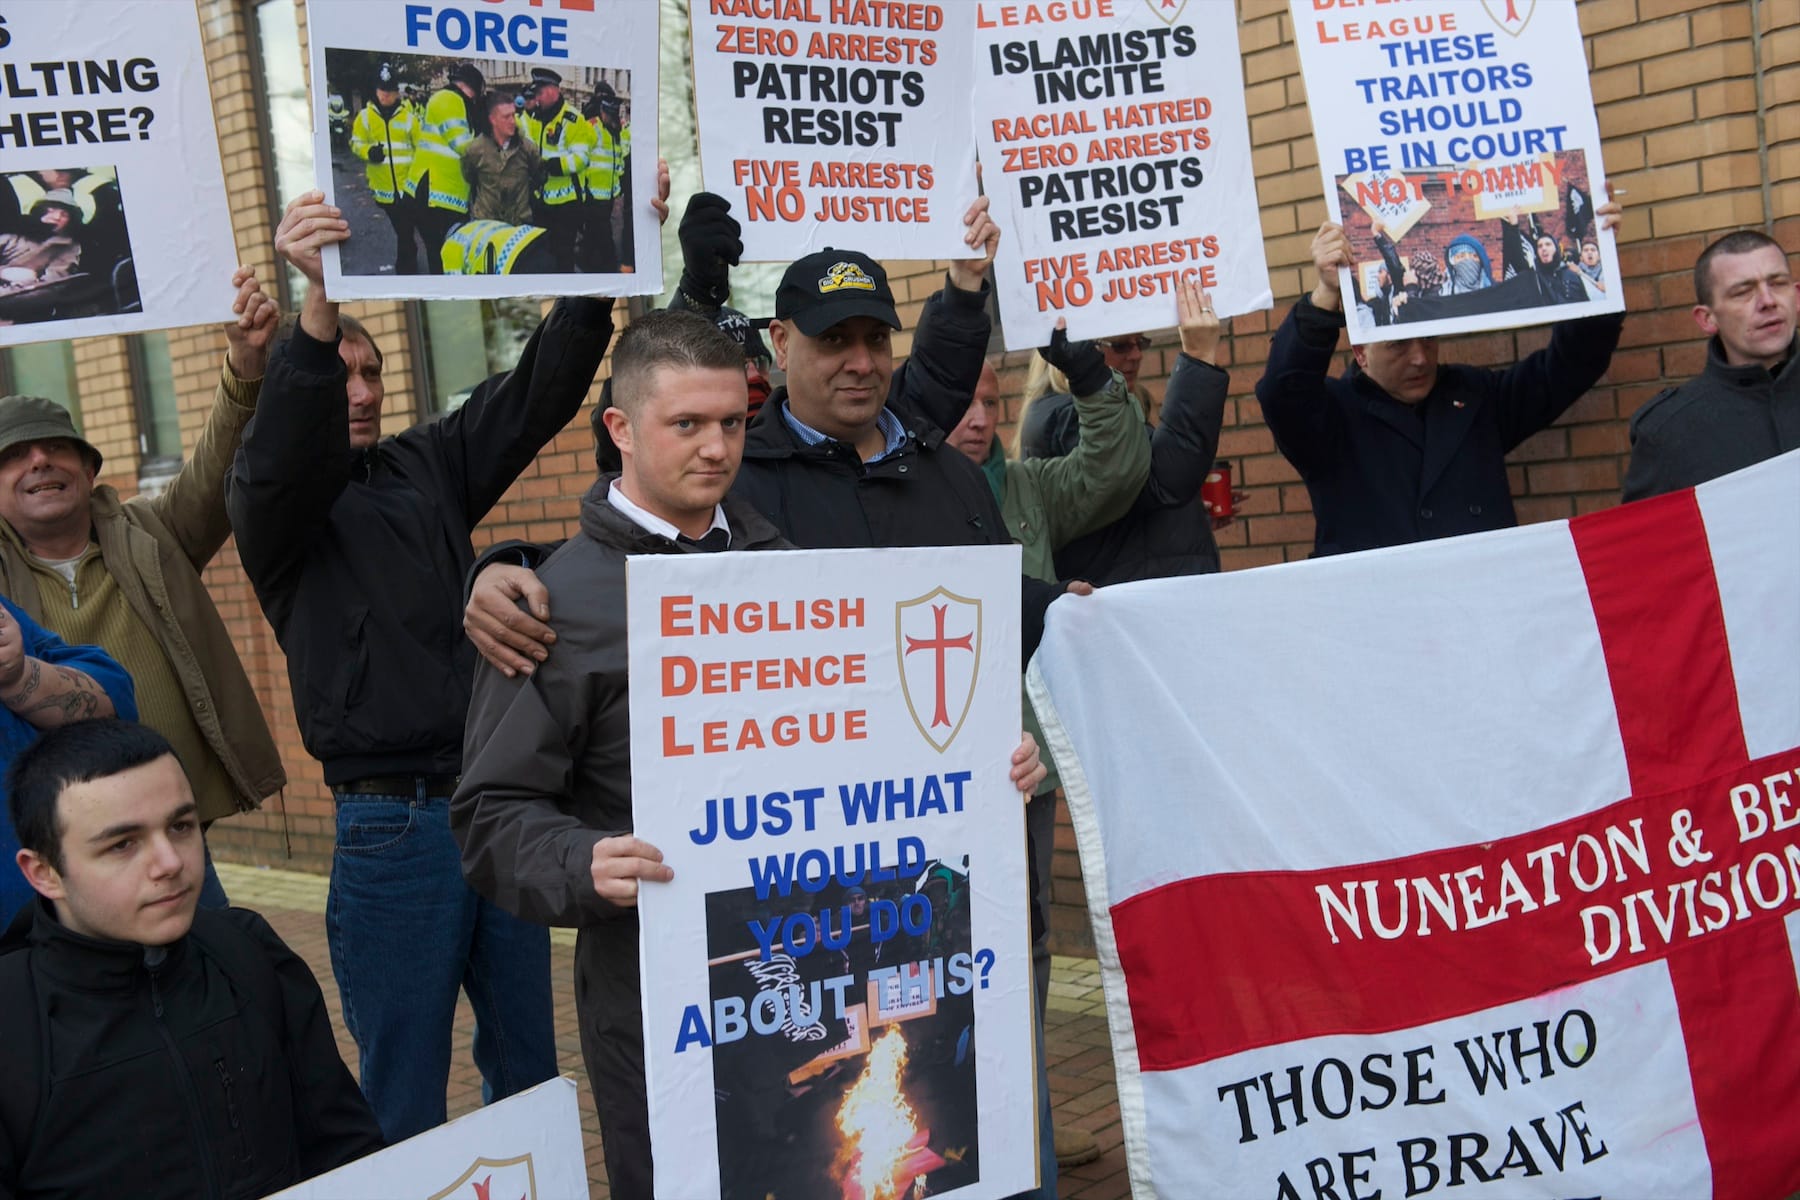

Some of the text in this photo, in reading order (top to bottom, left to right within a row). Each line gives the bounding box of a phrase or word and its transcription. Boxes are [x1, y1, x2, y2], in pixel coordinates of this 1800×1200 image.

[405, 4, 569, 58] FORCE
[709, 0, 943, 31] RACIAL HATRED
[977, 0, 1115, 28] LEAGUE
[1316, 13, 1457, 44] LEAGUE
[717, 25, 937, 65] ZERO ARRESTS
[990, 26, 1196, 75] ISLAMISTS
[1380, 33, 1497, 68] THESE
[0, 57, 160, 98] LTING
[733, 61, 924, 107] PATRIOTS
[1034, 61, 1165, 104] INCITE
[1356, 63, 1533, 104] TRAITORS
[762, 107, 902, 147] RESIST
[992, 97, 1212, 142] RACIAL HATRED
[1380, 98, 1522, 136] SHOULD
[1002, 127, 1211, 172] ZERO ARRESTS
[1344, 126, 1567, 174] BE IN COURT
[734, 159, 934, 190] FIVE ARRESTS
[1019, 157, 1203, 208] PATRIOTS
[1356, 174, 1428, 207] NOT
[1436, 158, 1567, 199] TOMMY
[745, 186, 930, 222] NO JUSTICE
[1049, 195, 1184, 242] RESIST
[1024, 236, 1220, 283] FIVE ARRESTS
[1036, 264, 1217, 311] NO JUSTICE
[660, 595, 865, 637] ENGLISH
[661, 653, 866, 697] DEFENCE
[661, 709, 867, 757] LEAGUE
[689, 771, 972, 846] JUST WHAT
[749, 837, 926, 901] WOULD
[1315, 767, 1800, 944] NUNEATON & BE
[747, 893, 933, 963] YOU DO
[674, 974, 855, 1054] ABOUT
[868, 948, 996, 1011] THIS?
[1218, 1010, 1597, 1143] THOSE WHO
[1276, 1101, 1608, 1200] ARE BRAVE
